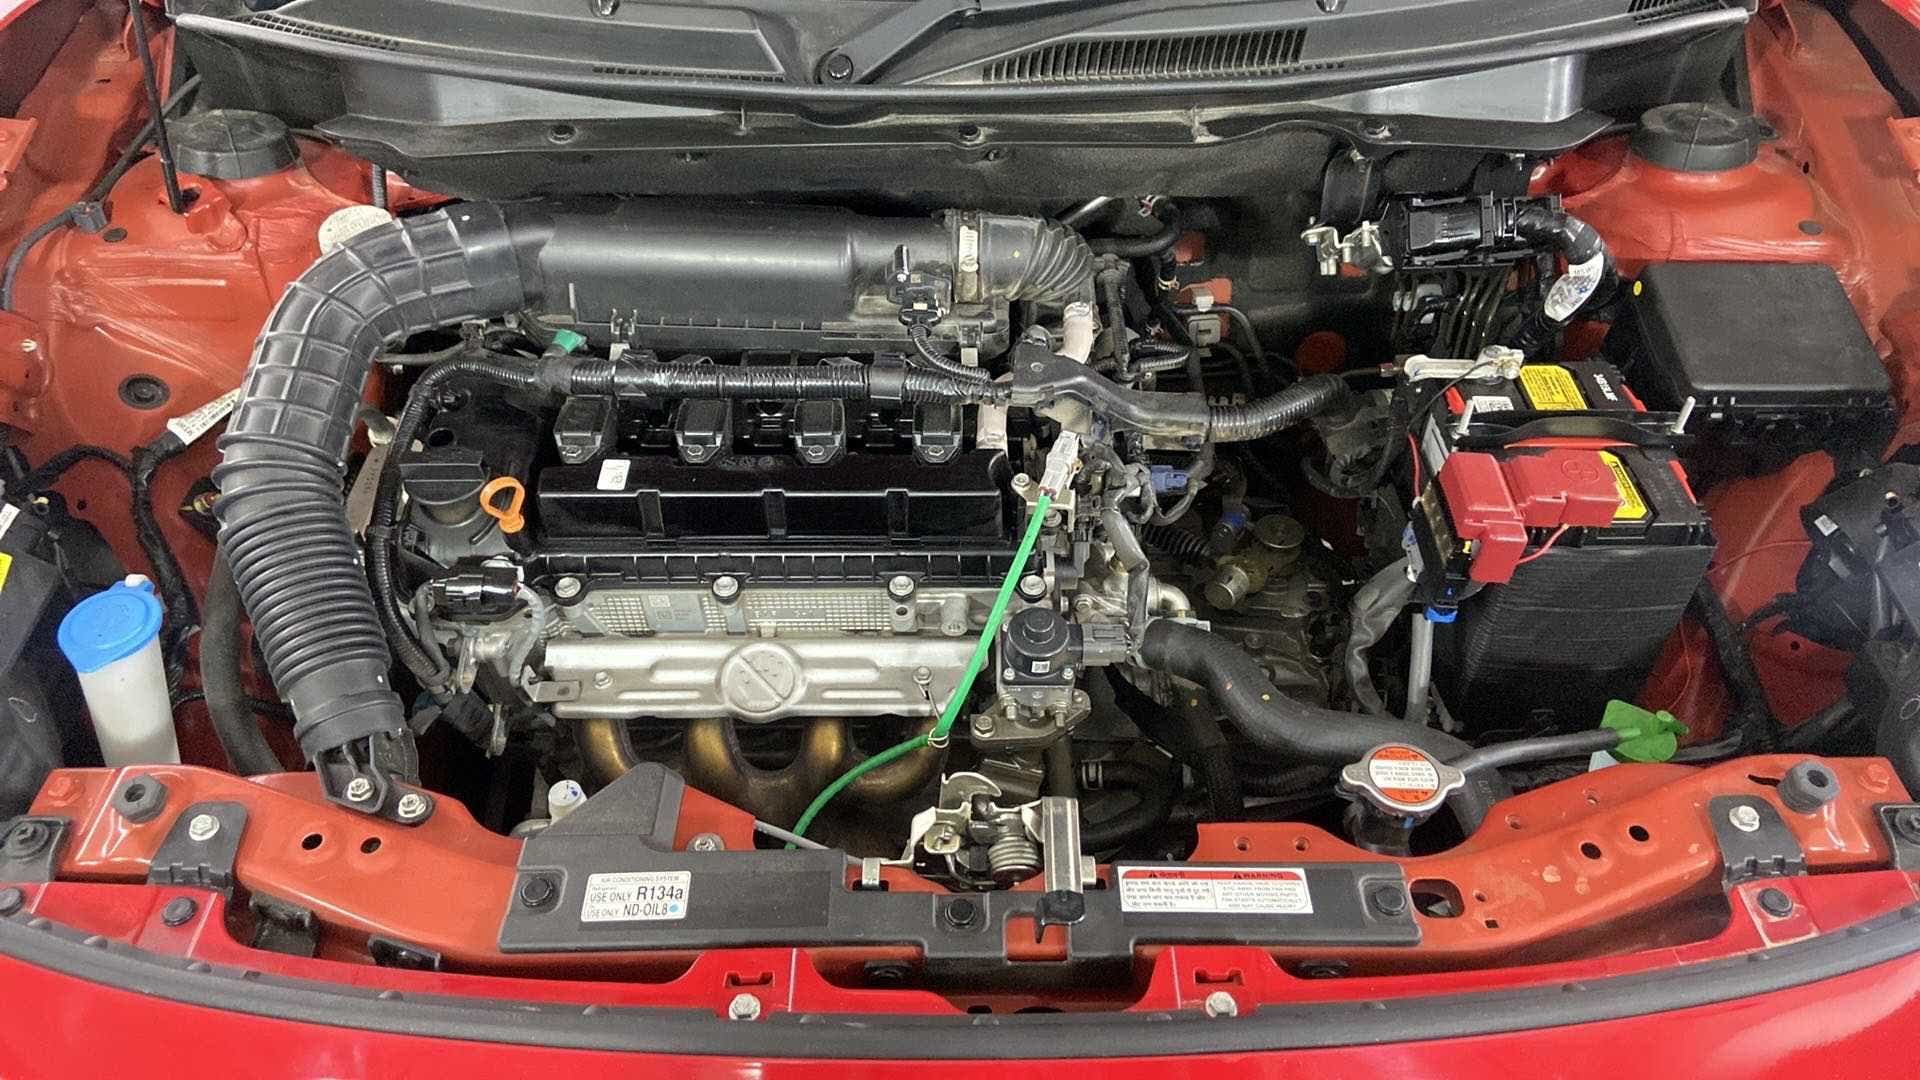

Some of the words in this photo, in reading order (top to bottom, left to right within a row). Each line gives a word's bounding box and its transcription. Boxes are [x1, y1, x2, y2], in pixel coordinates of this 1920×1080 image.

[1243, 872, 1284, 880] WARNING
[591, 892, 608, 902] USE
[609, 891, 632, 902] ONLY
[636, 885, 684, 901] R134a
[601, 908, 619, 917] ONLY
